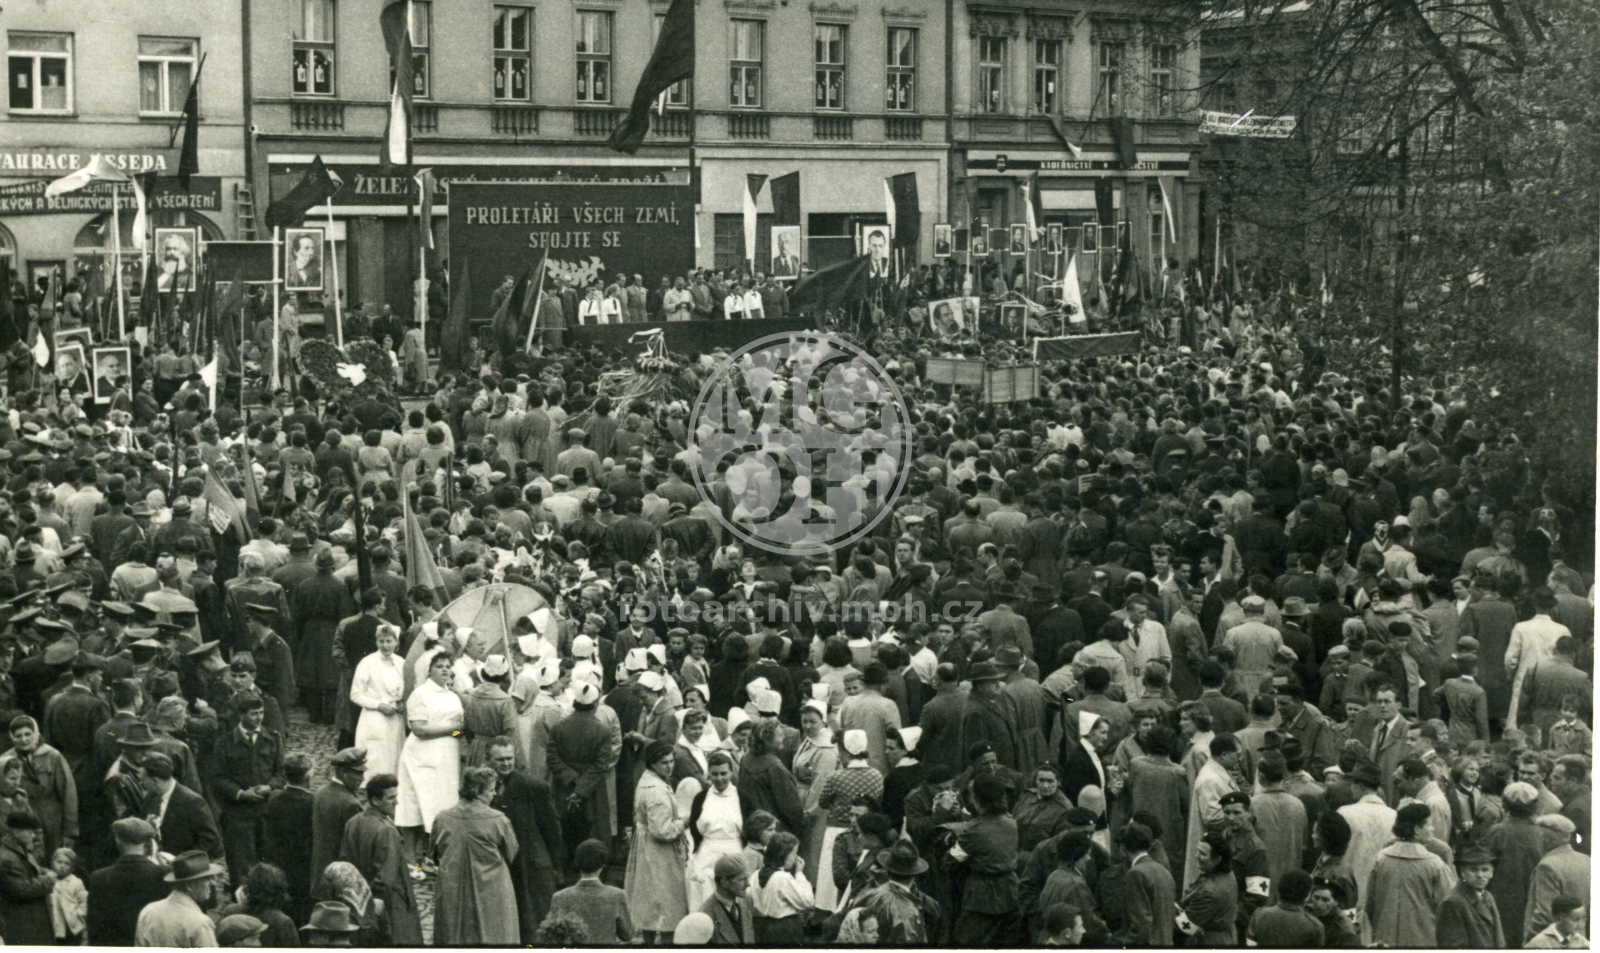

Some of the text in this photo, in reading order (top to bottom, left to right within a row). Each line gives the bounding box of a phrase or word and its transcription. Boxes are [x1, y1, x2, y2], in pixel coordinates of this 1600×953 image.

[90, 154, 167, 170] ESEDA
[0, 195, 33, 211] KÝCH
[36, 197, 44, 209] A
[117, 197, 152, 209] STR
[156, 190, 188, 208] VŠECH
[466, 201, 680, 226] PROLETÁŘI VŠECH ZEMÍ,
[602, 231, 622, 248] SE
